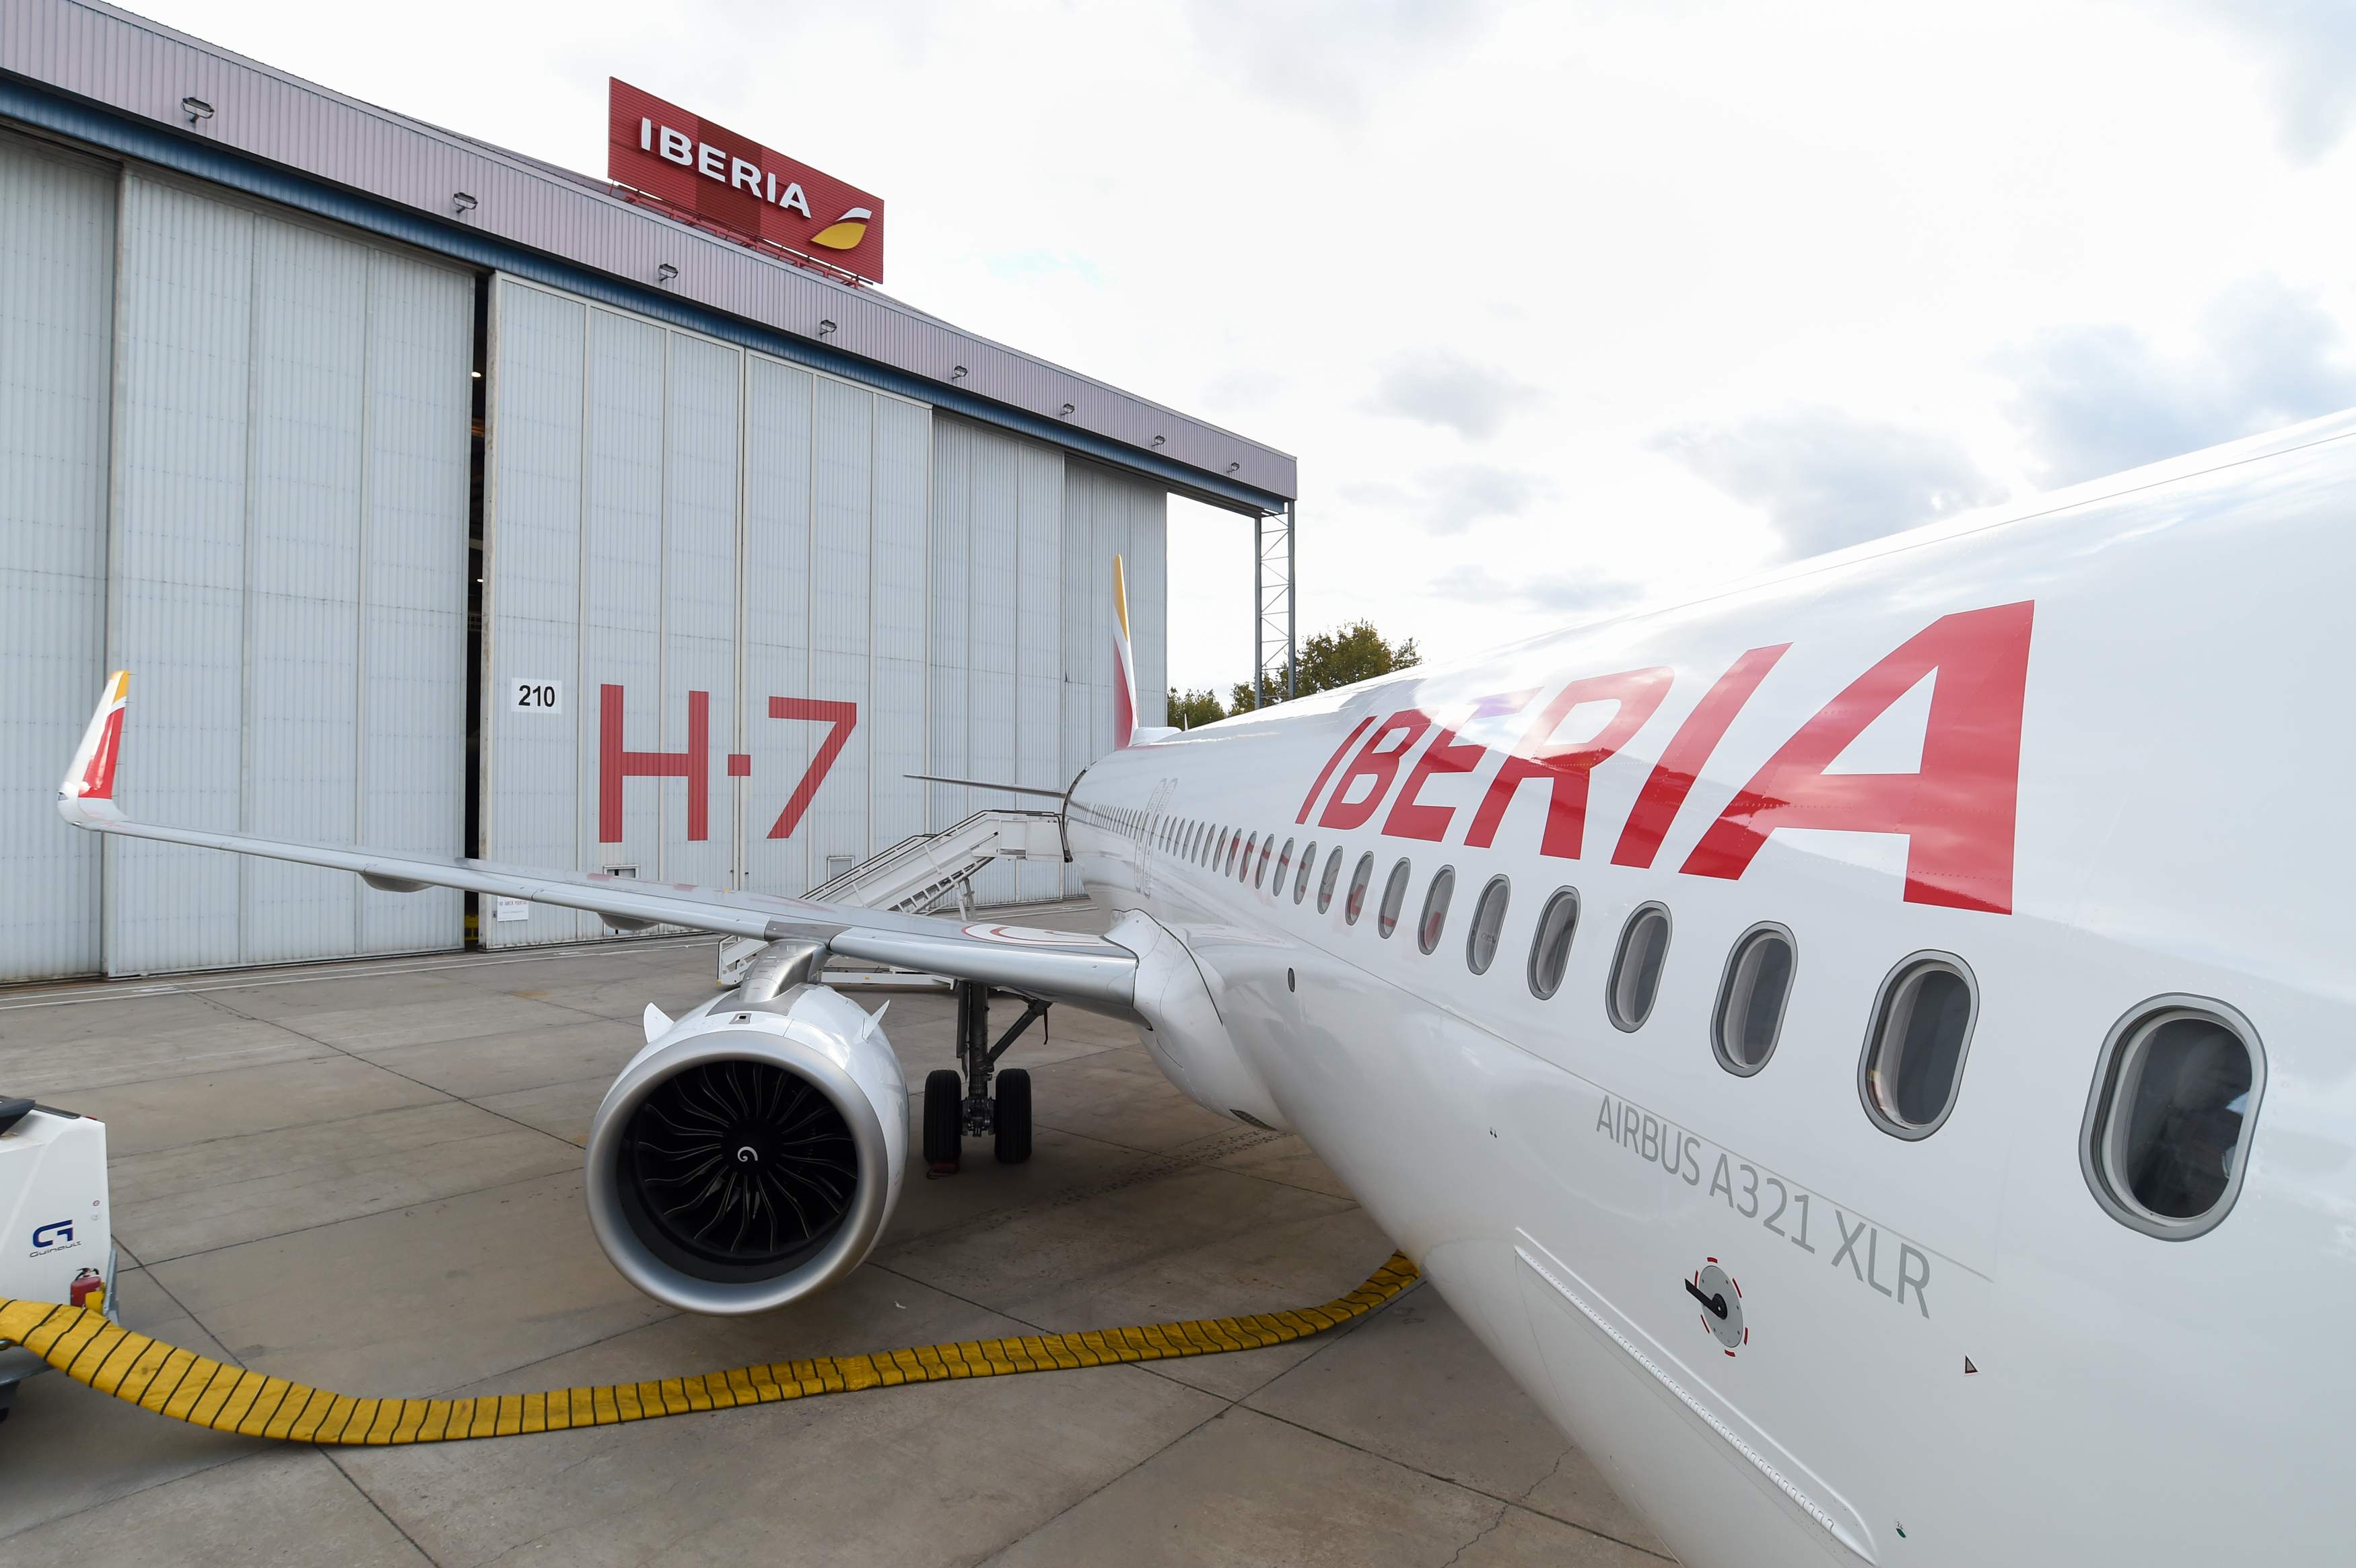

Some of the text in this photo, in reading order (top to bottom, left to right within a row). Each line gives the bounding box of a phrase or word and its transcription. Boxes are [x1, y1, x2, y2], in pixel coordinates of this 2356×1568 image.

[641, 116, 812, 219] IBERIA
[518, 684, 555, 707] 210
[1294, 599, 2035, 915] IBERIA
[30, 1241, 82, 1258] Guinault
[1596, 1094, 1931, 1320] AIRBUS A321 XLR
